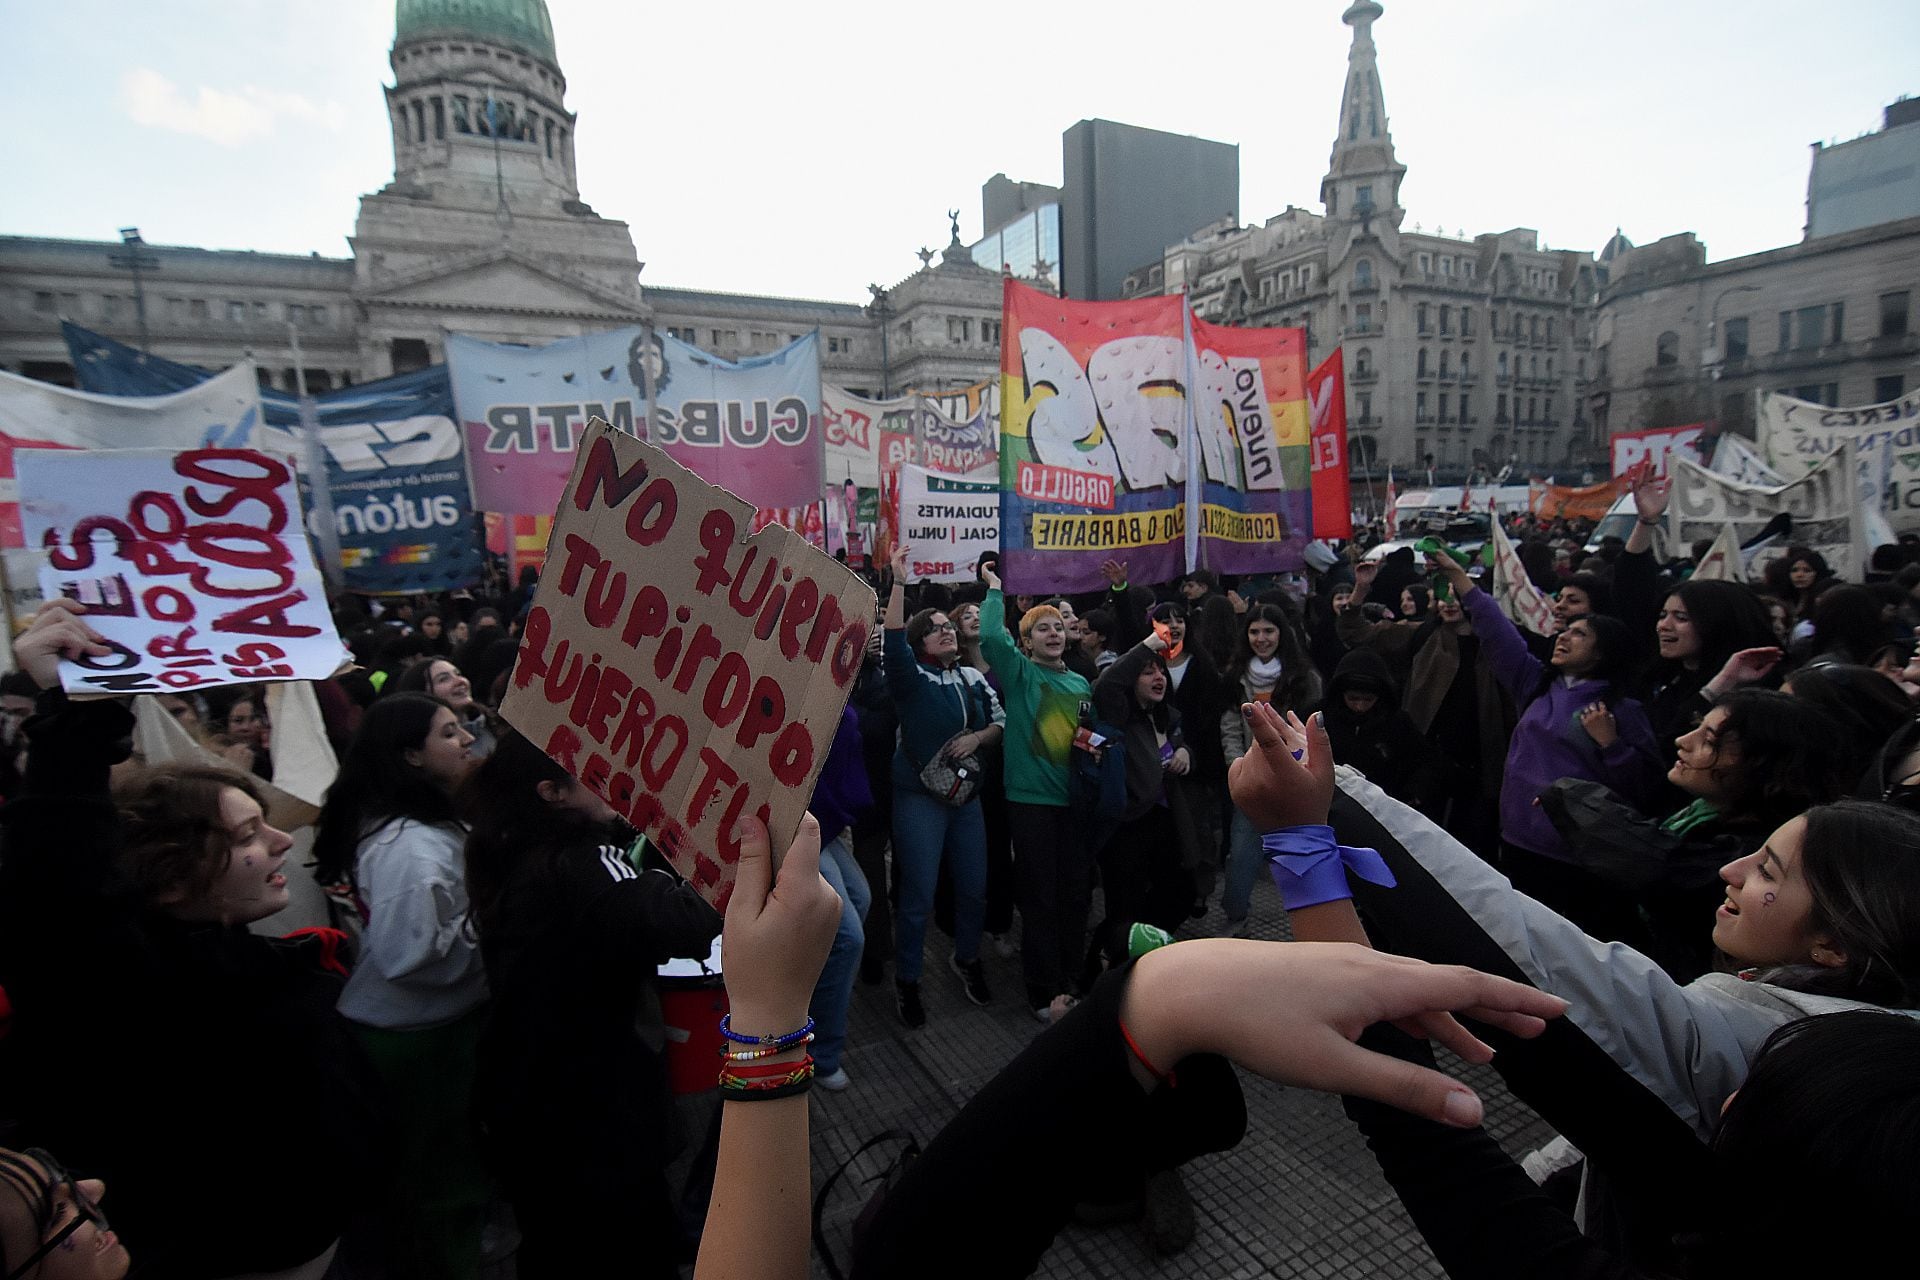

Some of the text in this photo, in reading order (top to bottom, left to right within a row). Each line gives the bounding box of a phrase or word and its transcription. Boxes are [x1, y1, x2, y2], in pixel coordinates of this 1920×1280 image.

[574, 436, 678, 546] NO
[173, 447, 322, 679] ES ACOSO
[558, 533, 627, 628] TU
[76, 630, 162, 692] NO
[686, 746, 771, 864] TU
